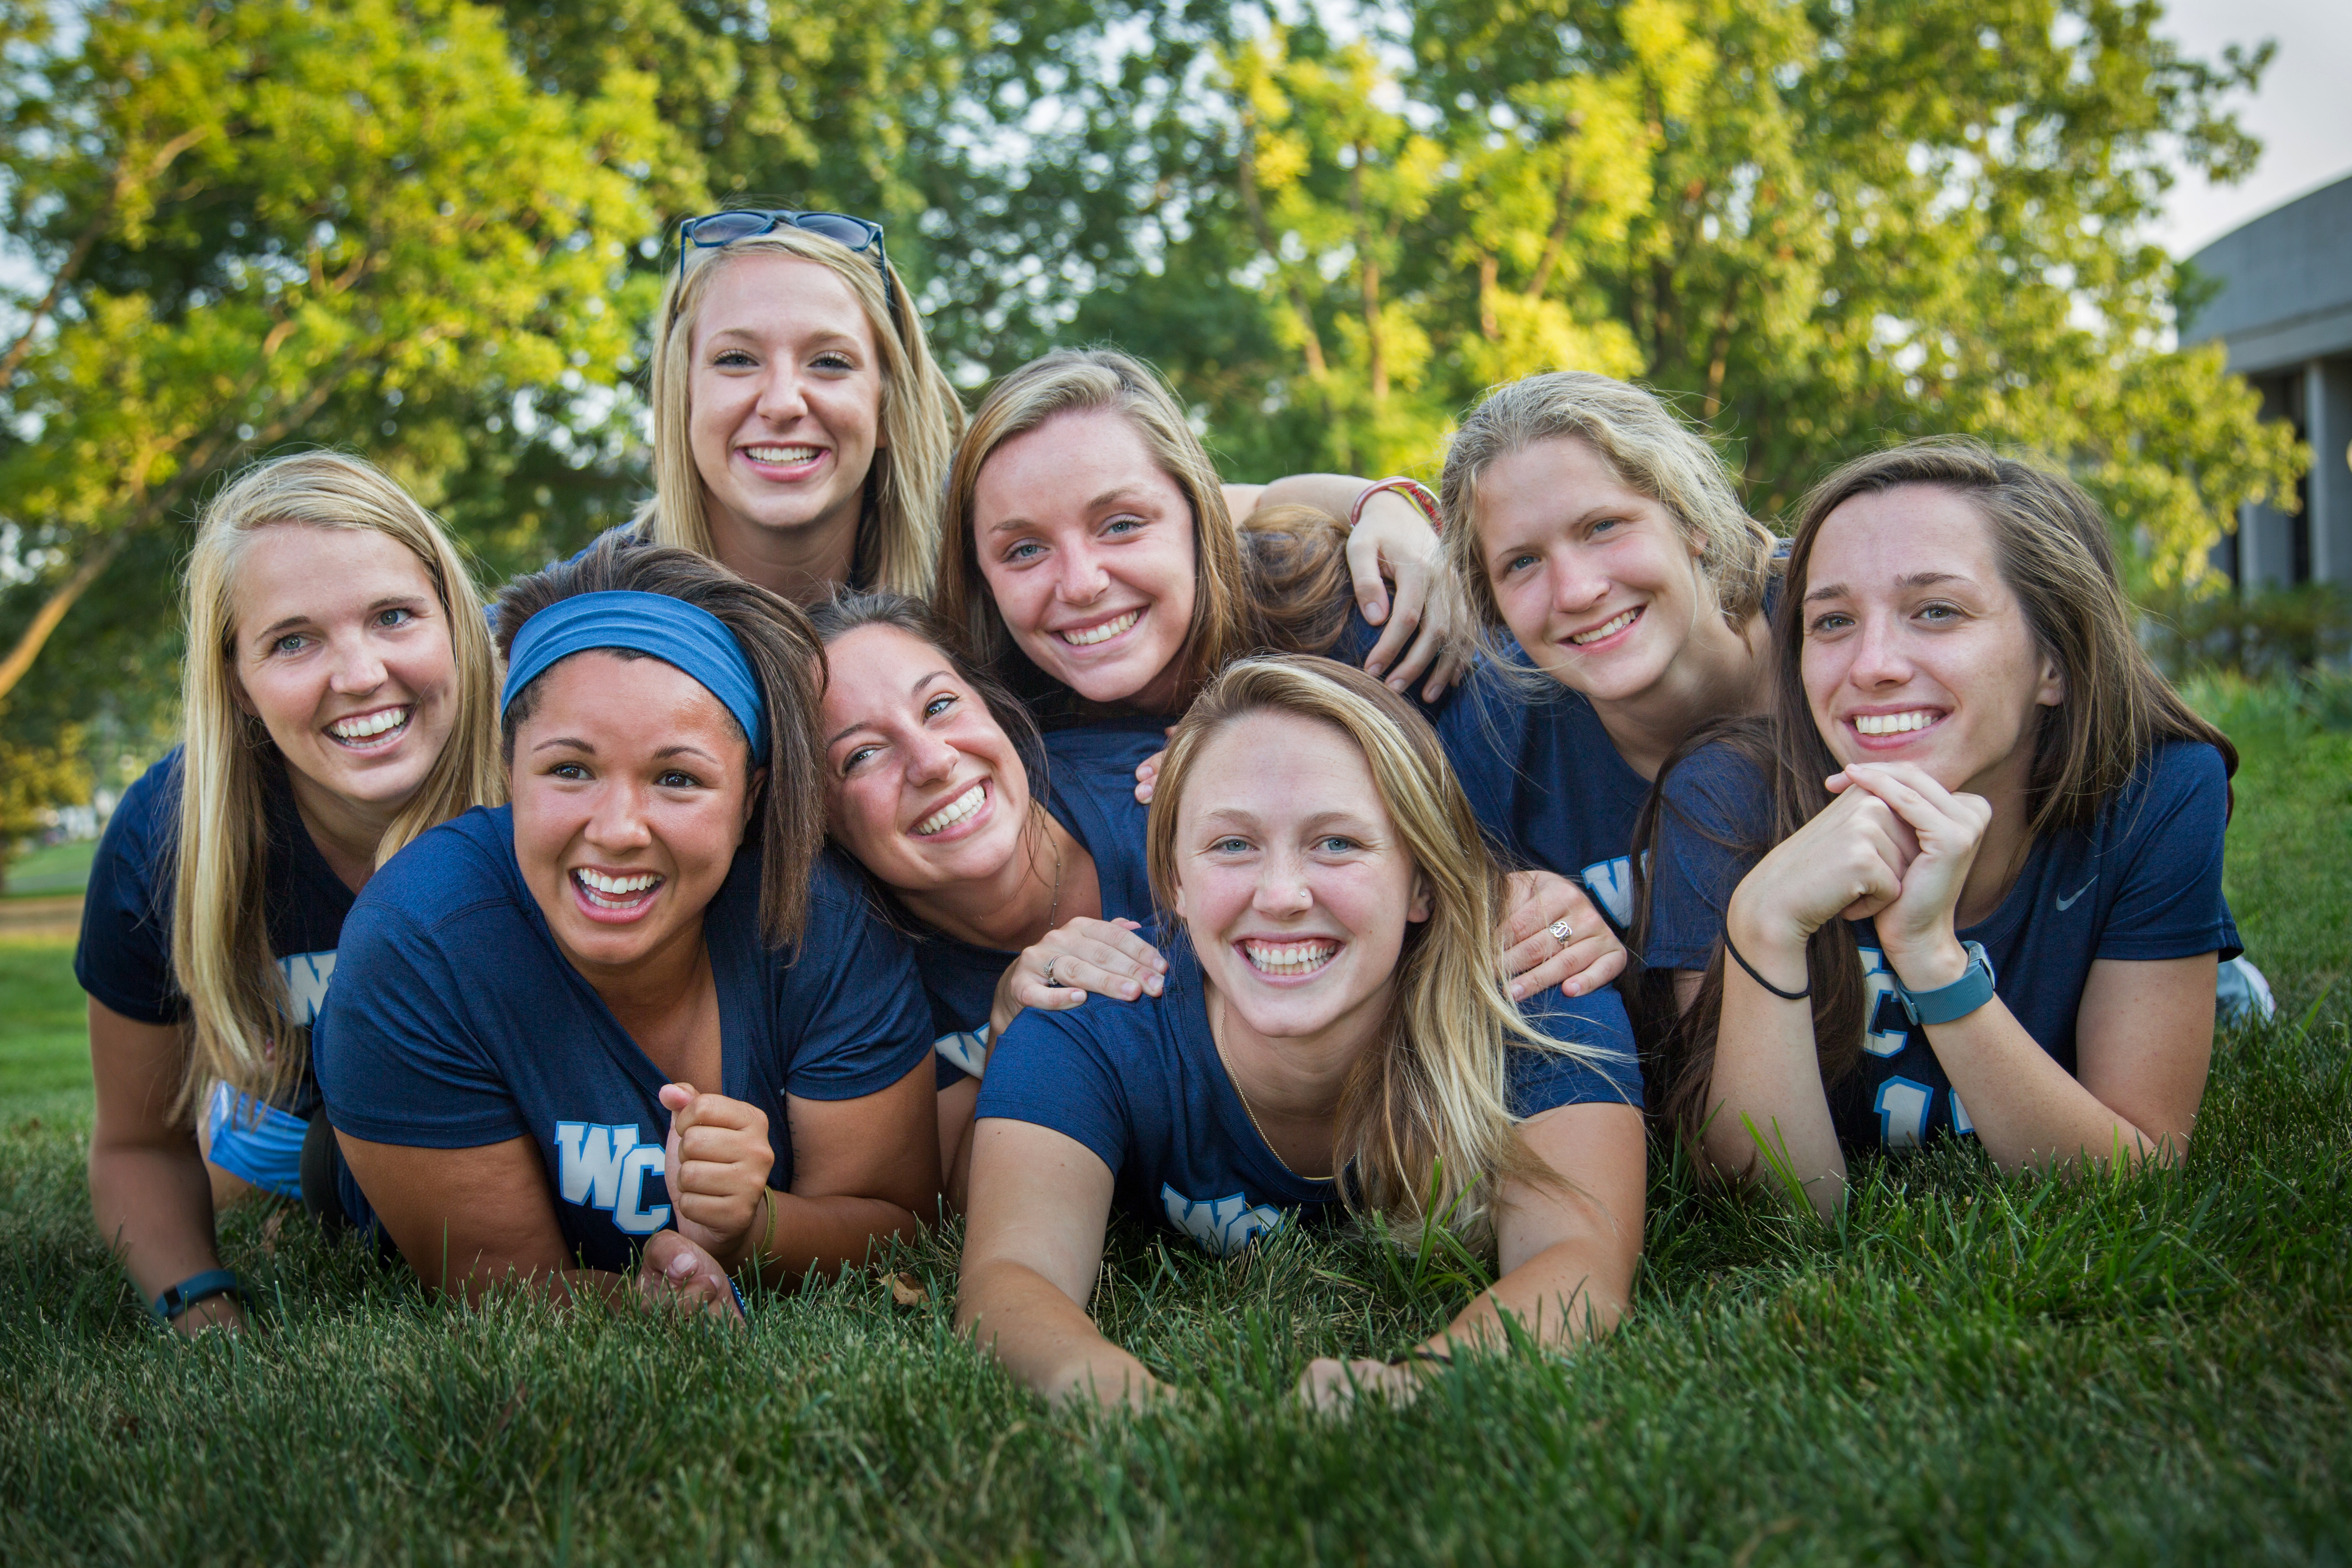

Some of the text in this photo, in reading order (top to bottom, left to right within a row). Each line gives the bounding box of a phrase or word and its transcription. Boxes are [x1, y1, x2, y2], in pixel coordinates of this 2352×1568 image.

[1857, 946, 1908, 1058] C
[1873, 1075, 1976, 1152] 1
[554, 1121, 671, 1234] WC
